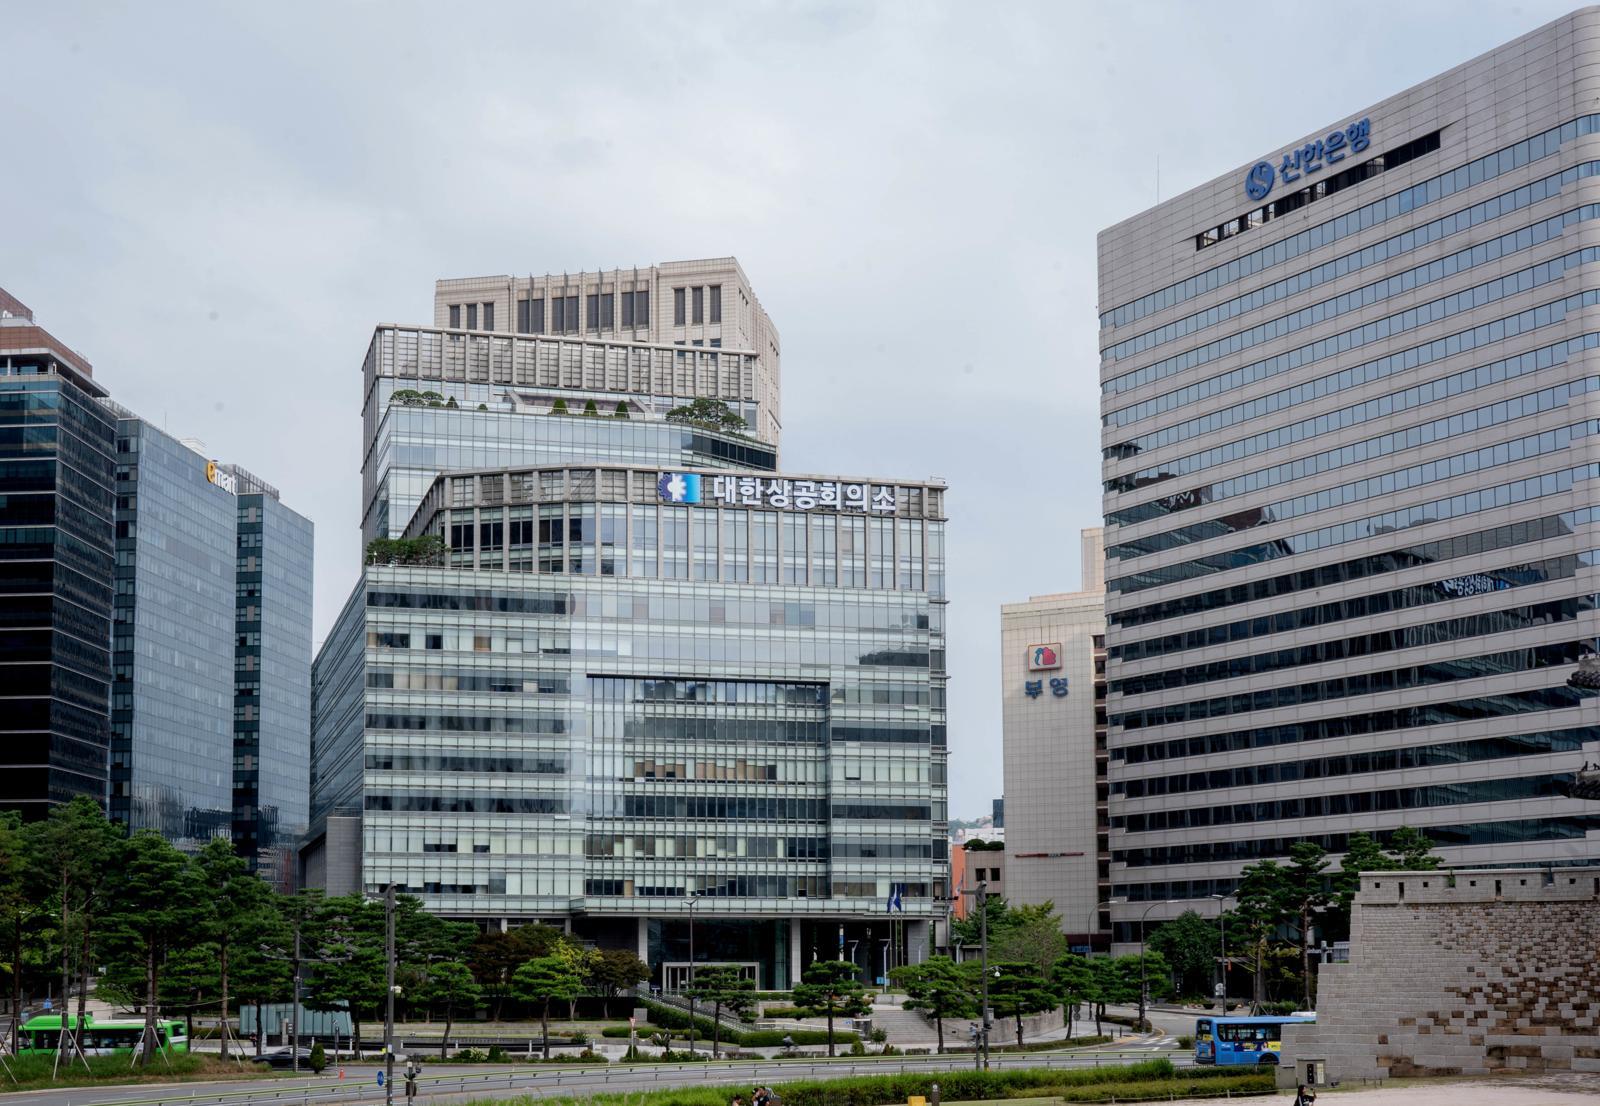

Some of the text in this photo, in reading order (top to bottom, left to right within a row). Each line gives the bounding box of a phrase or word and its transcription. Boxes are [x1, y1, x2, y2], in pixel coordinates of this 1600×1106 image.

[1279, 117, 1371, 184] 신한은행
[206, 461, 237, 496] emart
[713, 475, 896, 512] 대한상공회의소
[1025, 677, 1069, 699] 부영
